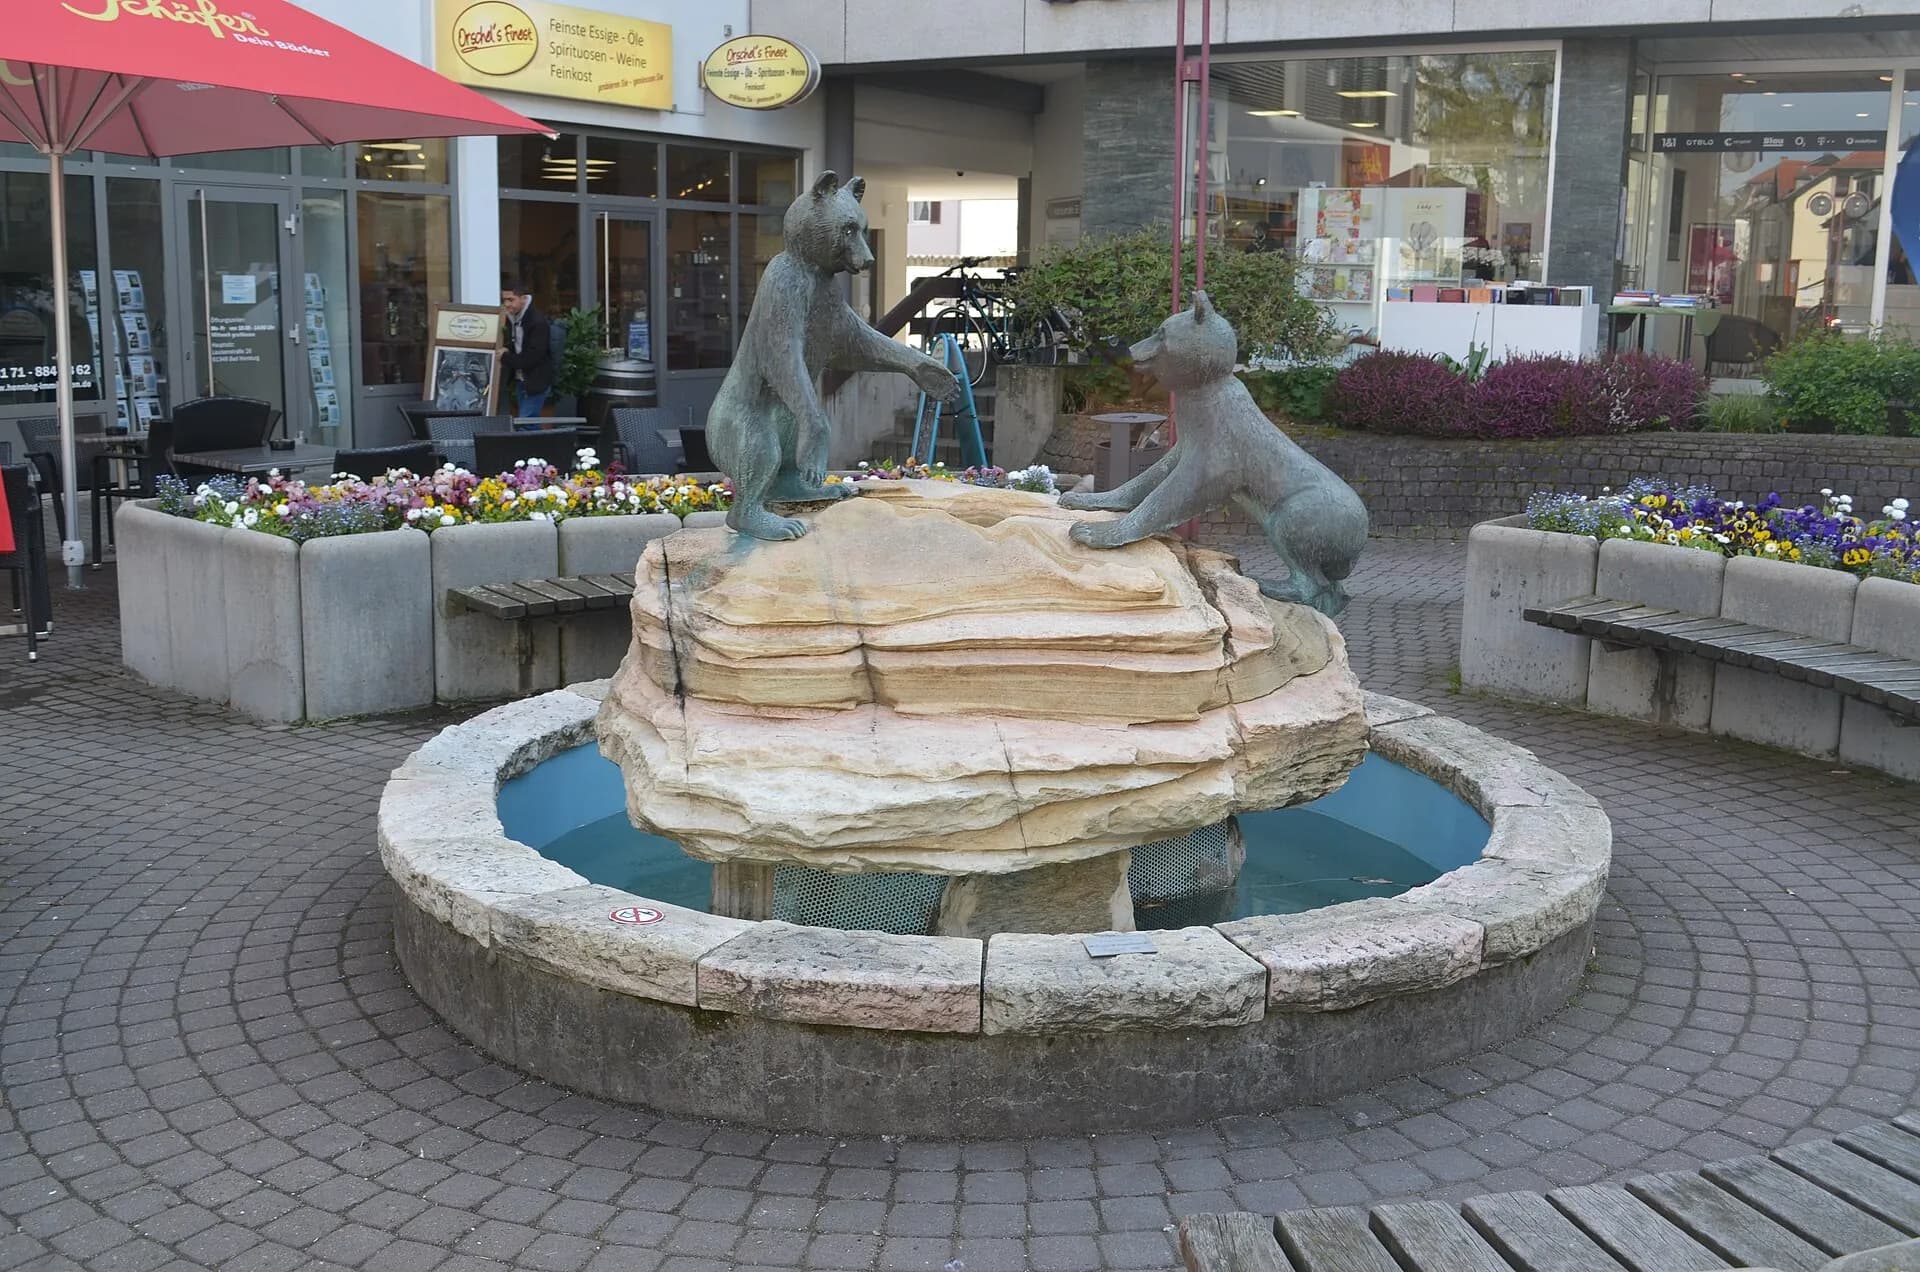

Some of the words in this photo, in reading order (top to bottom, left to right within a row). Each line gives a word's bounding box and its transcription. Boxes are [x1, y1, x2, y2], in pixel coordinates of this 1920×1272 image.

[458, 23, 502, 47] Orschel's
[504, 24, 533, 43] Finest
[549, 18, 586, 37] Feinste
[589, 25, 619, 44] Essige
[627, 29, 645, 47] Öle
[232, 33, 275, 48] Dein
[274, 40, 330, 57] Bäcker
[549, 41, 607, 63] Spirituosen
[616, 52, 647, 69] Weine
[764, 45, 788, 59] Finest
[550, 64, 593, 82] Feinkost
[1661, 137, 1677, 148] 1&1
[1763, 137, 1784, 145] Blau
[35, 365, 58, 377] 884
[76, 364, 92, 376] 62
